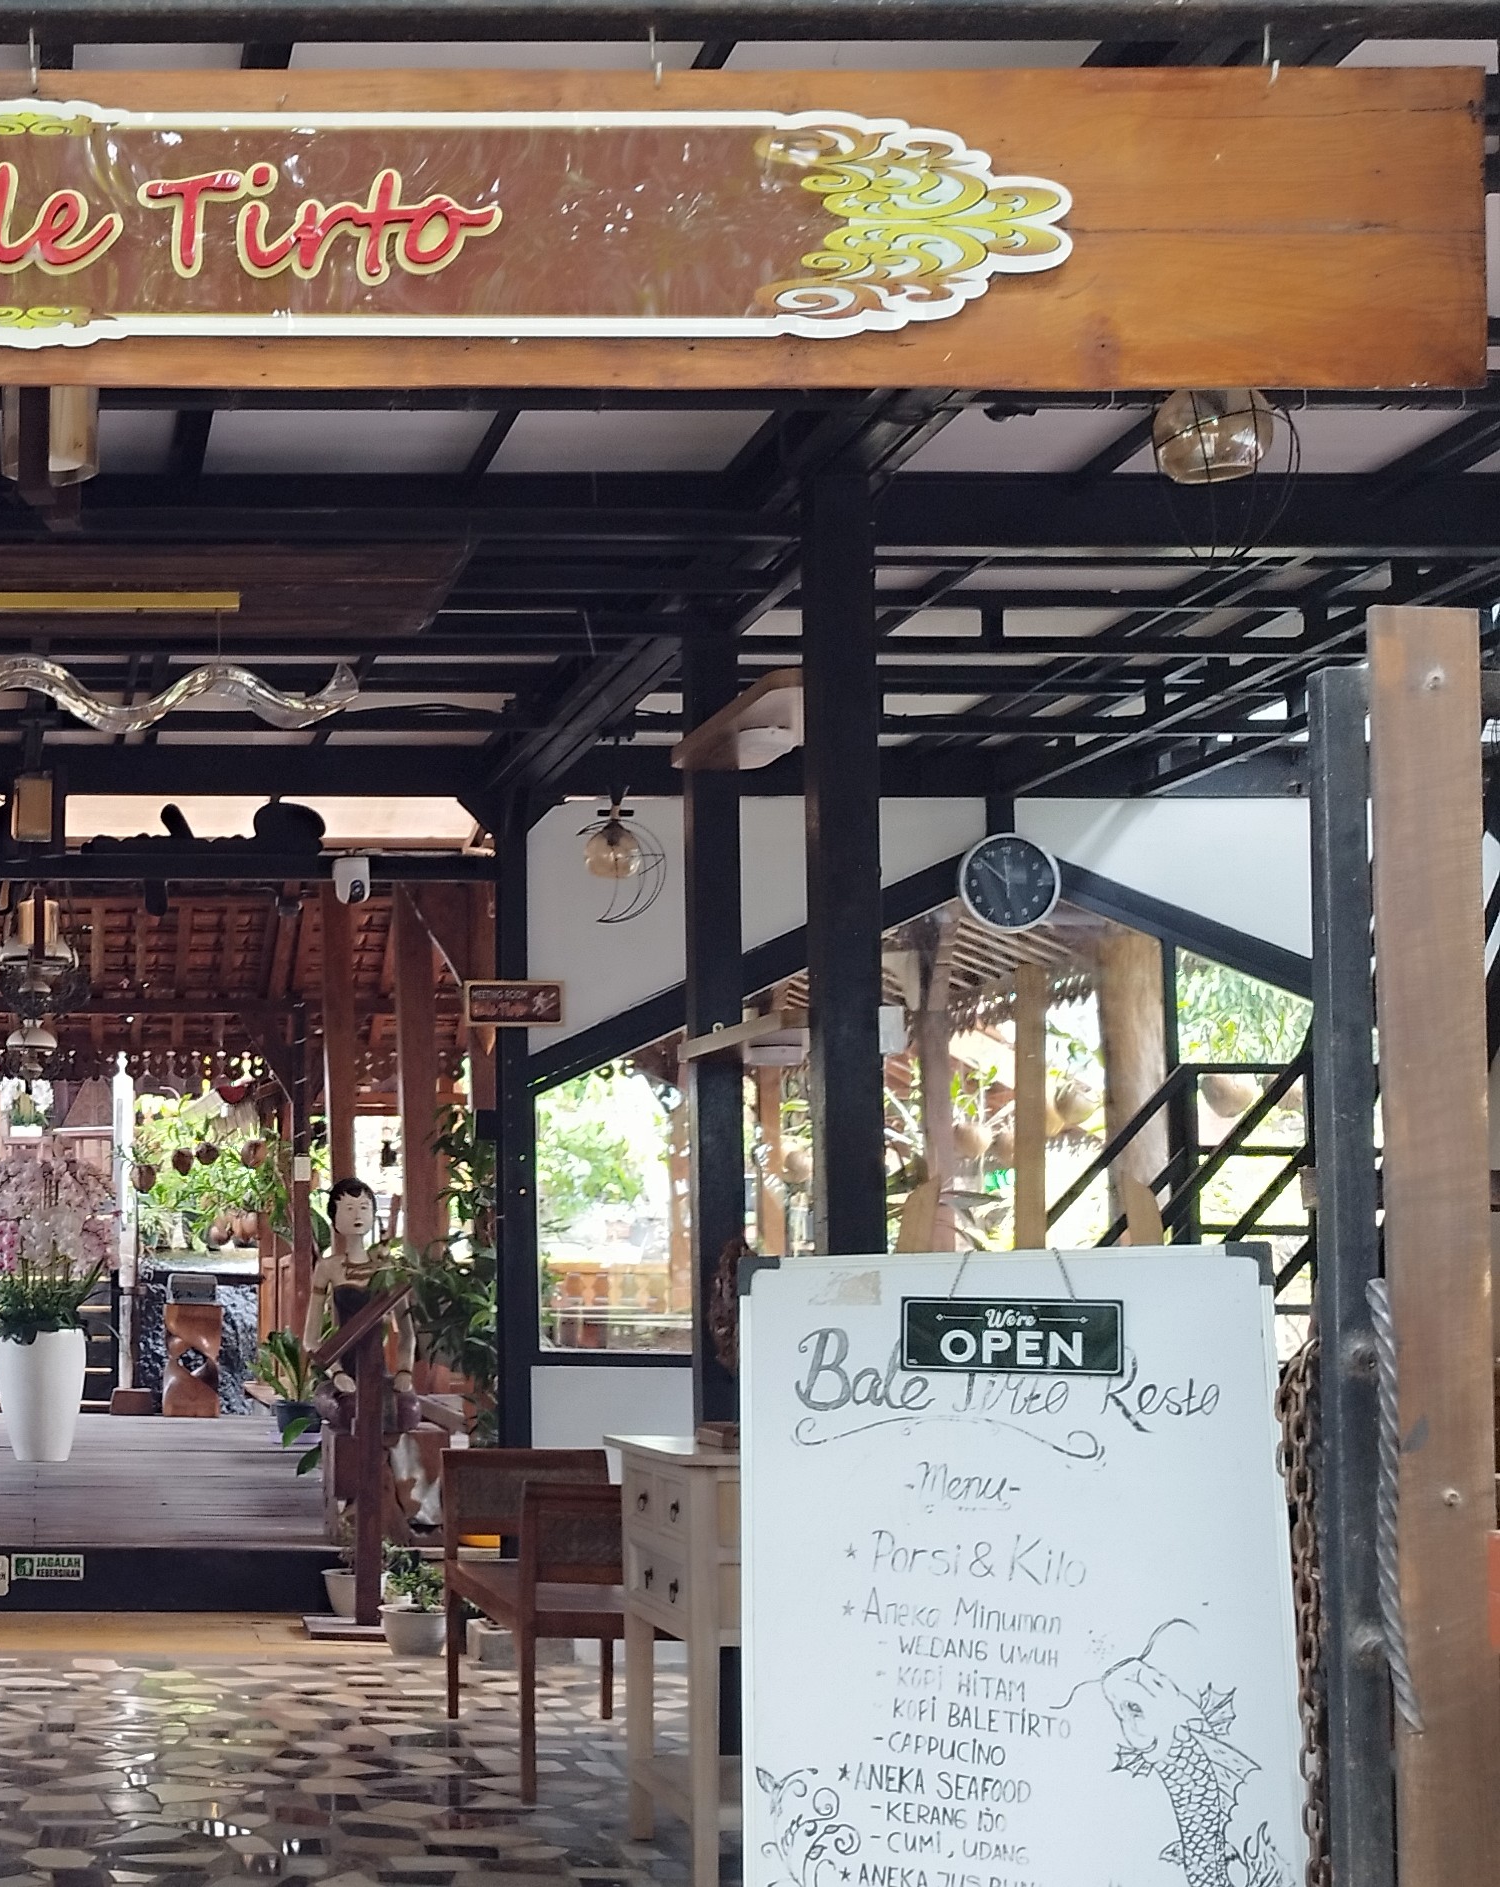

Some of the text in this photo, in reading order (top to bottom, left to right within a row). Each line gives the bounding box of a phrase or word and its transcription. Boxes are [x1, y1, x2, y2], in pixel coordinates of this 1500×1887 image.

[138, 161, 502, 287] Tirto
[505, 990, 529, 999] ROOM
[984, 1308, 1037, 1328] We're
[940, 1329, 1083, 1366] OPEN
[795, 1327, 936, 1411] Bale
[36, 1557, 81, 1568] JAGALAH
[36, 1568, 80, 1577] KEBERSIHAN
[872, 1529, 962, 1576] Porsi
[1008, 1534, 1087, 1587] Kilo
[863, 1586, 1062, 1635] Aneka Minuman
[899, 1635, 1059, 1667] WEDANG UWUH
[854, 1762, 1032, 1803] ANEKA SEAFOOD
[887, 1801, 967, 1829] KERANG
[962, 1839, 1030, 1865] UDANG
[859, 1863, 928, 1887] ANEKA
